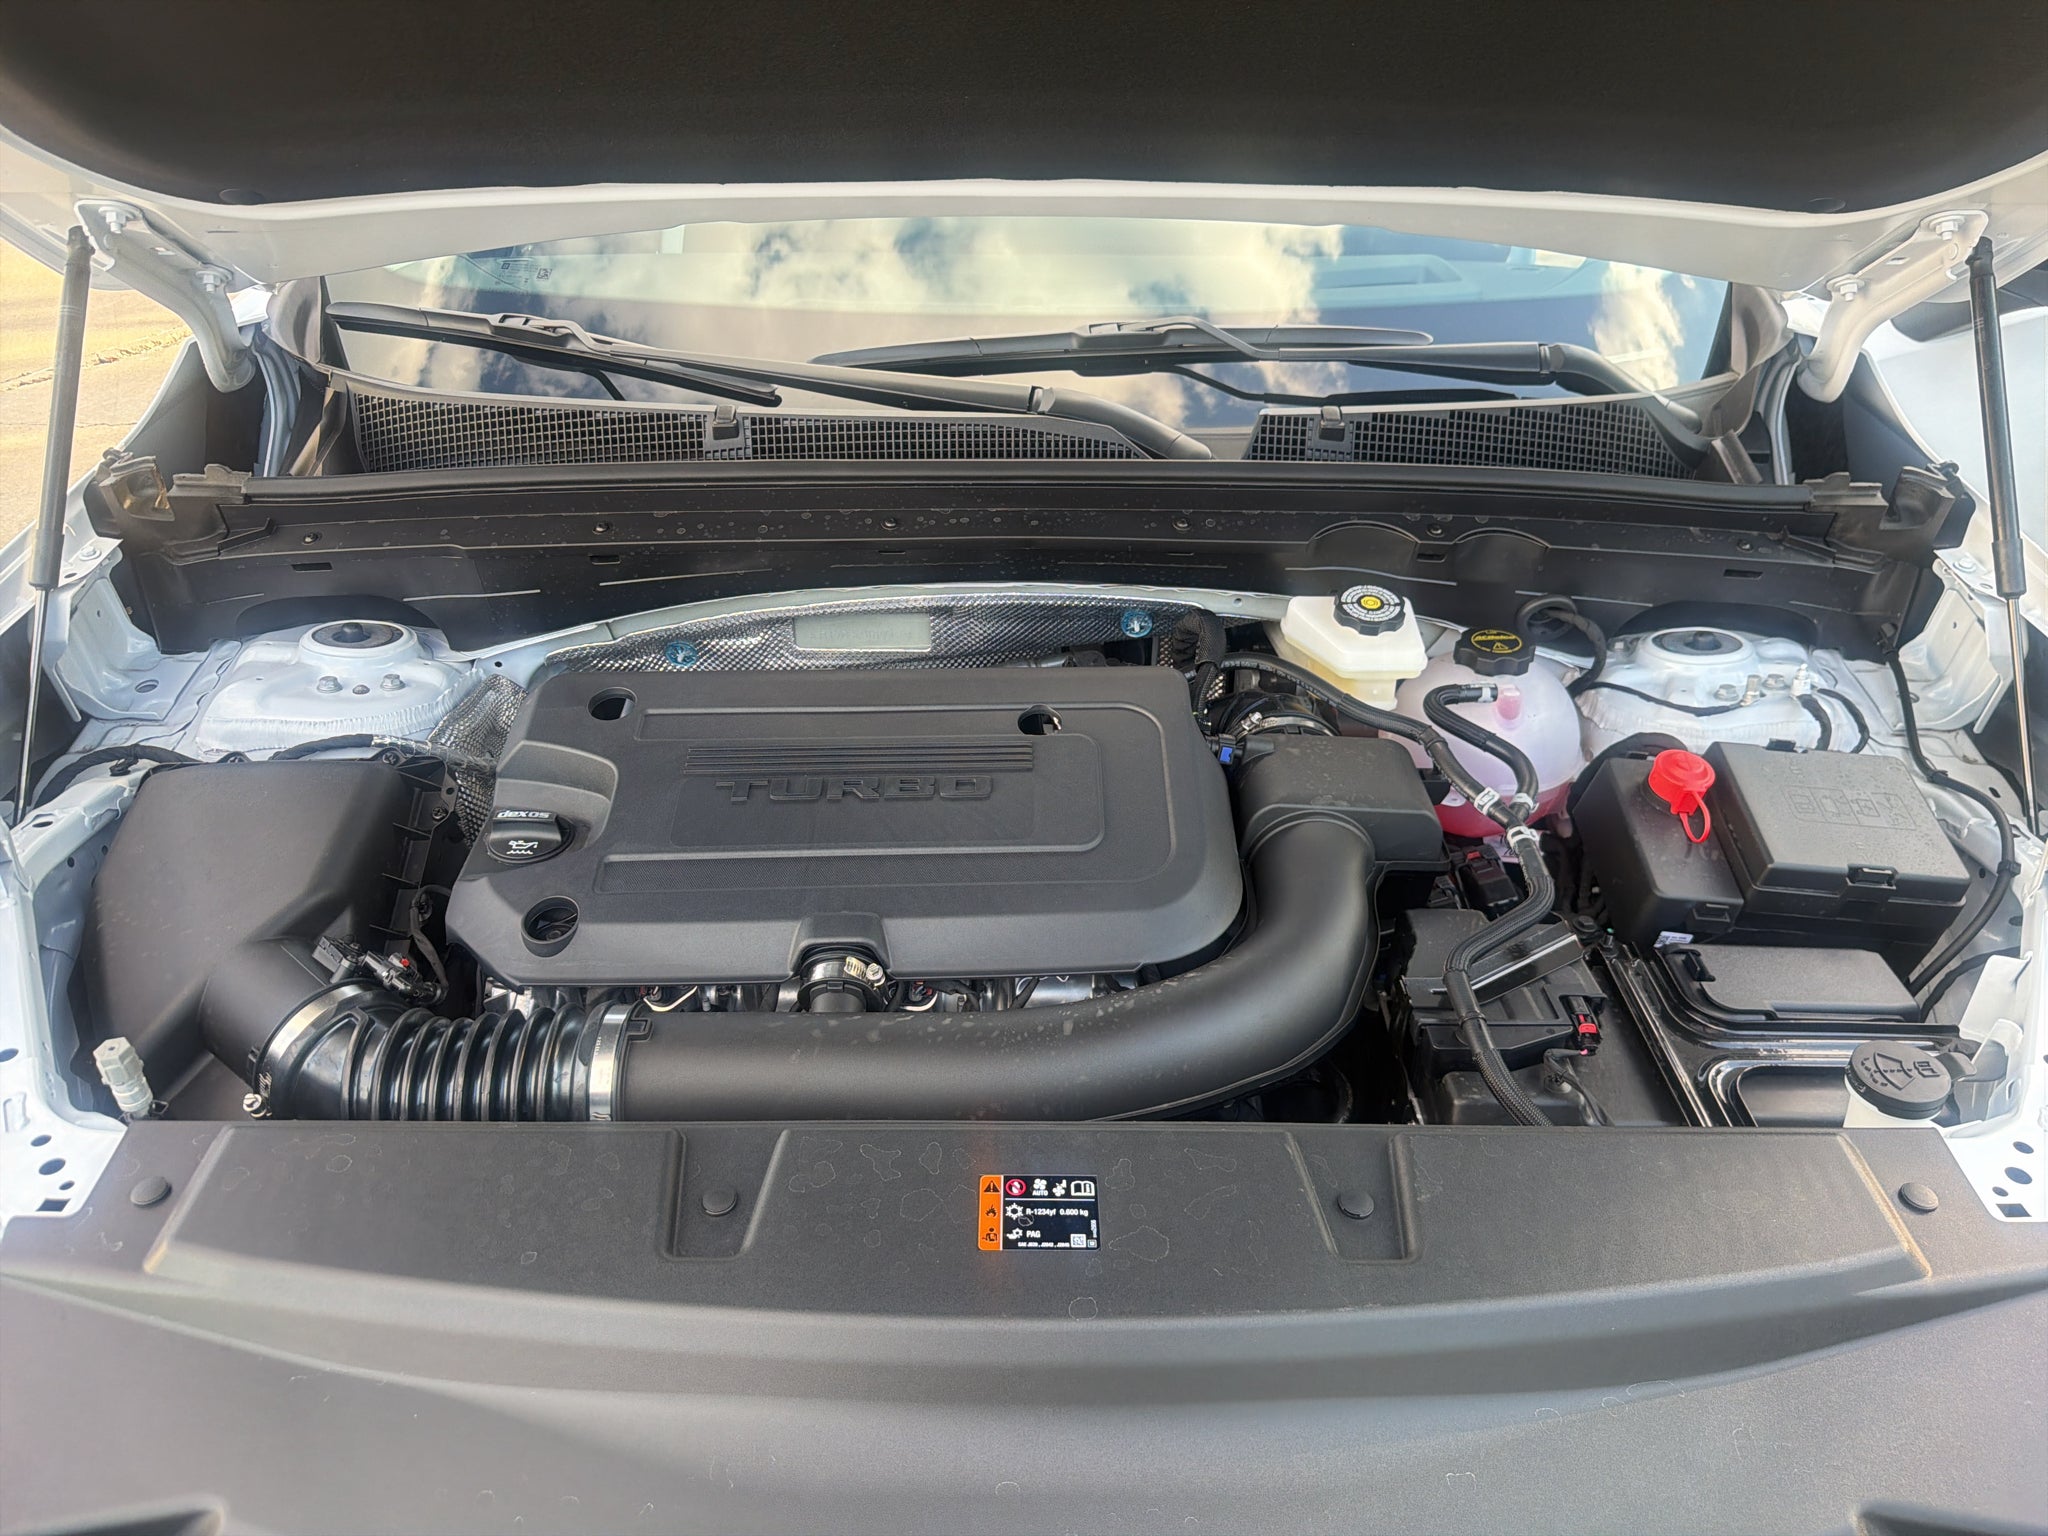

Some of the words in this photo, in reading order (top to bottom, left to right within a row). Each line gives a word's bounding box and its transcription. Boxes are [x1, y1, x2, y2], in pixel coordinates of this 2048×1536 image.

[715, 775, 993, 802] TURBO
[497, 810, 551, 819] dexos
[1025, 1208, 1056, 1217] R-1234yf
[1079, 1208, 1089, 1217] kg
[1026, 1230, 1041, 1238] PAG
